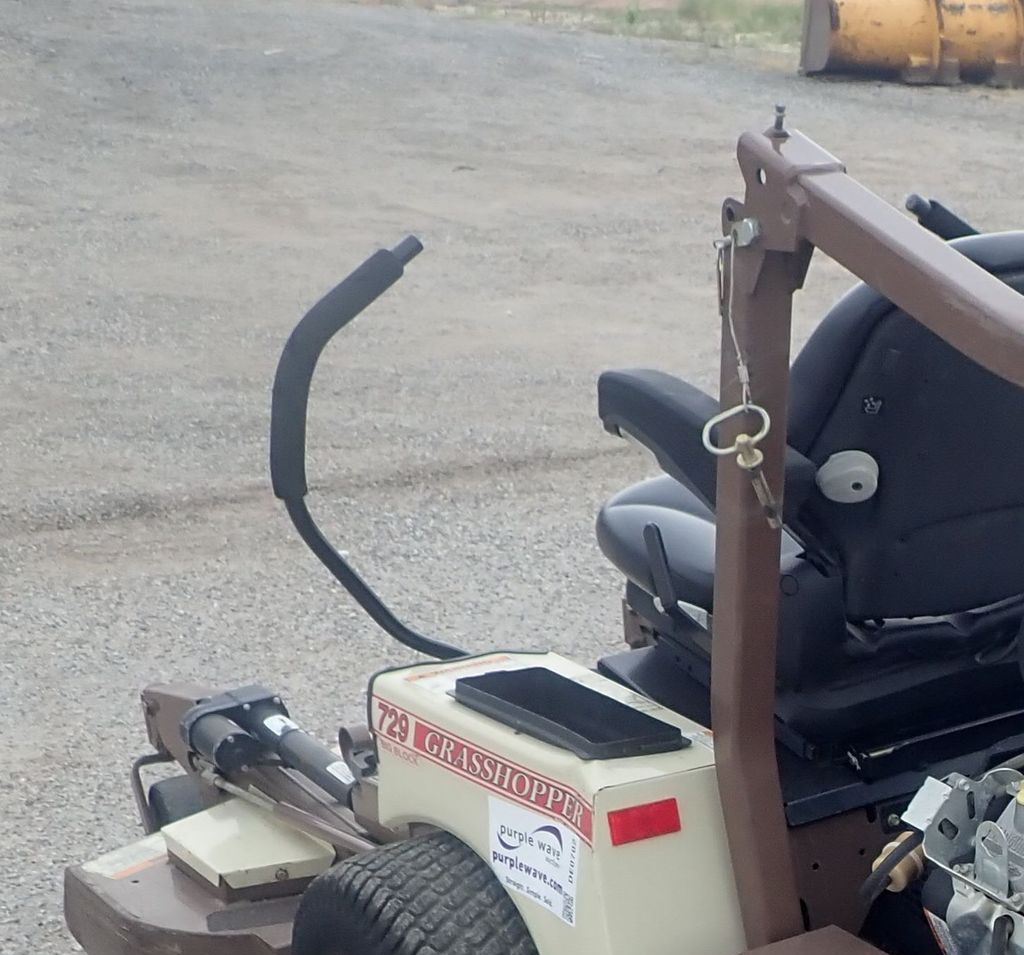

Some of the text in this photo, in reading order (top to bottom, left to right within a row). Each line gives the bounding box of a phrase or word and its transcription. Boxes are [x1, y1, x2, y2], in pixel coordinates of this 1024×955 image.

[377, 702, 584, 828] 729 GRASSHOPPER
[500, 825, 560, 861] purple wave
[492, 850, 564, 895] purplewave.com
